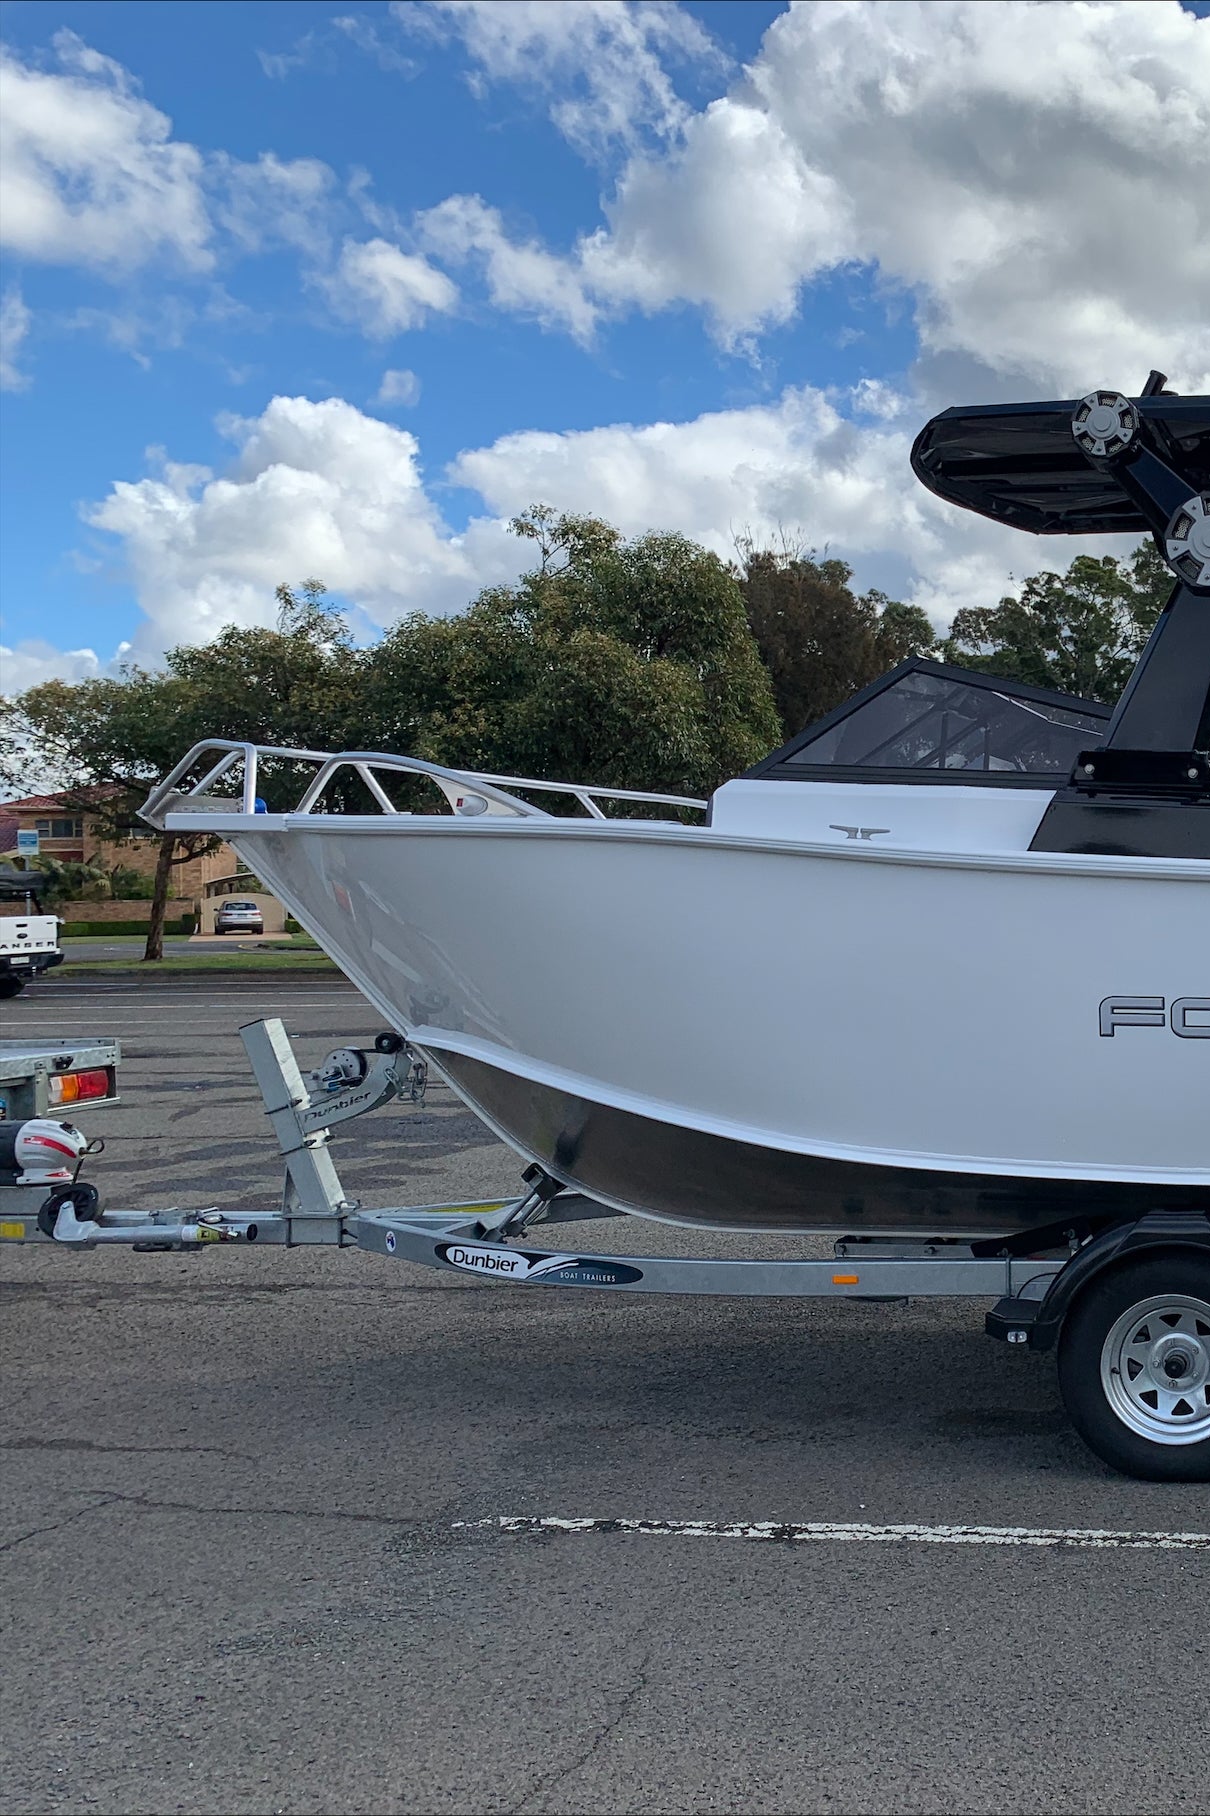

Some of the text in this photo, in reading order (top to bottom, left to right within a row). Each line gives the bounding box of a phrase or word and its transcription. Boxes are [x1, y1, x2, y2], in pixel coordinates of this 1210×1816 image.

[0, 941, 55, 949] ANGER
[453, 1249, 519, 1272] Dunbier
[560, 1271, 616, 1283] BOAT TRAILERS
